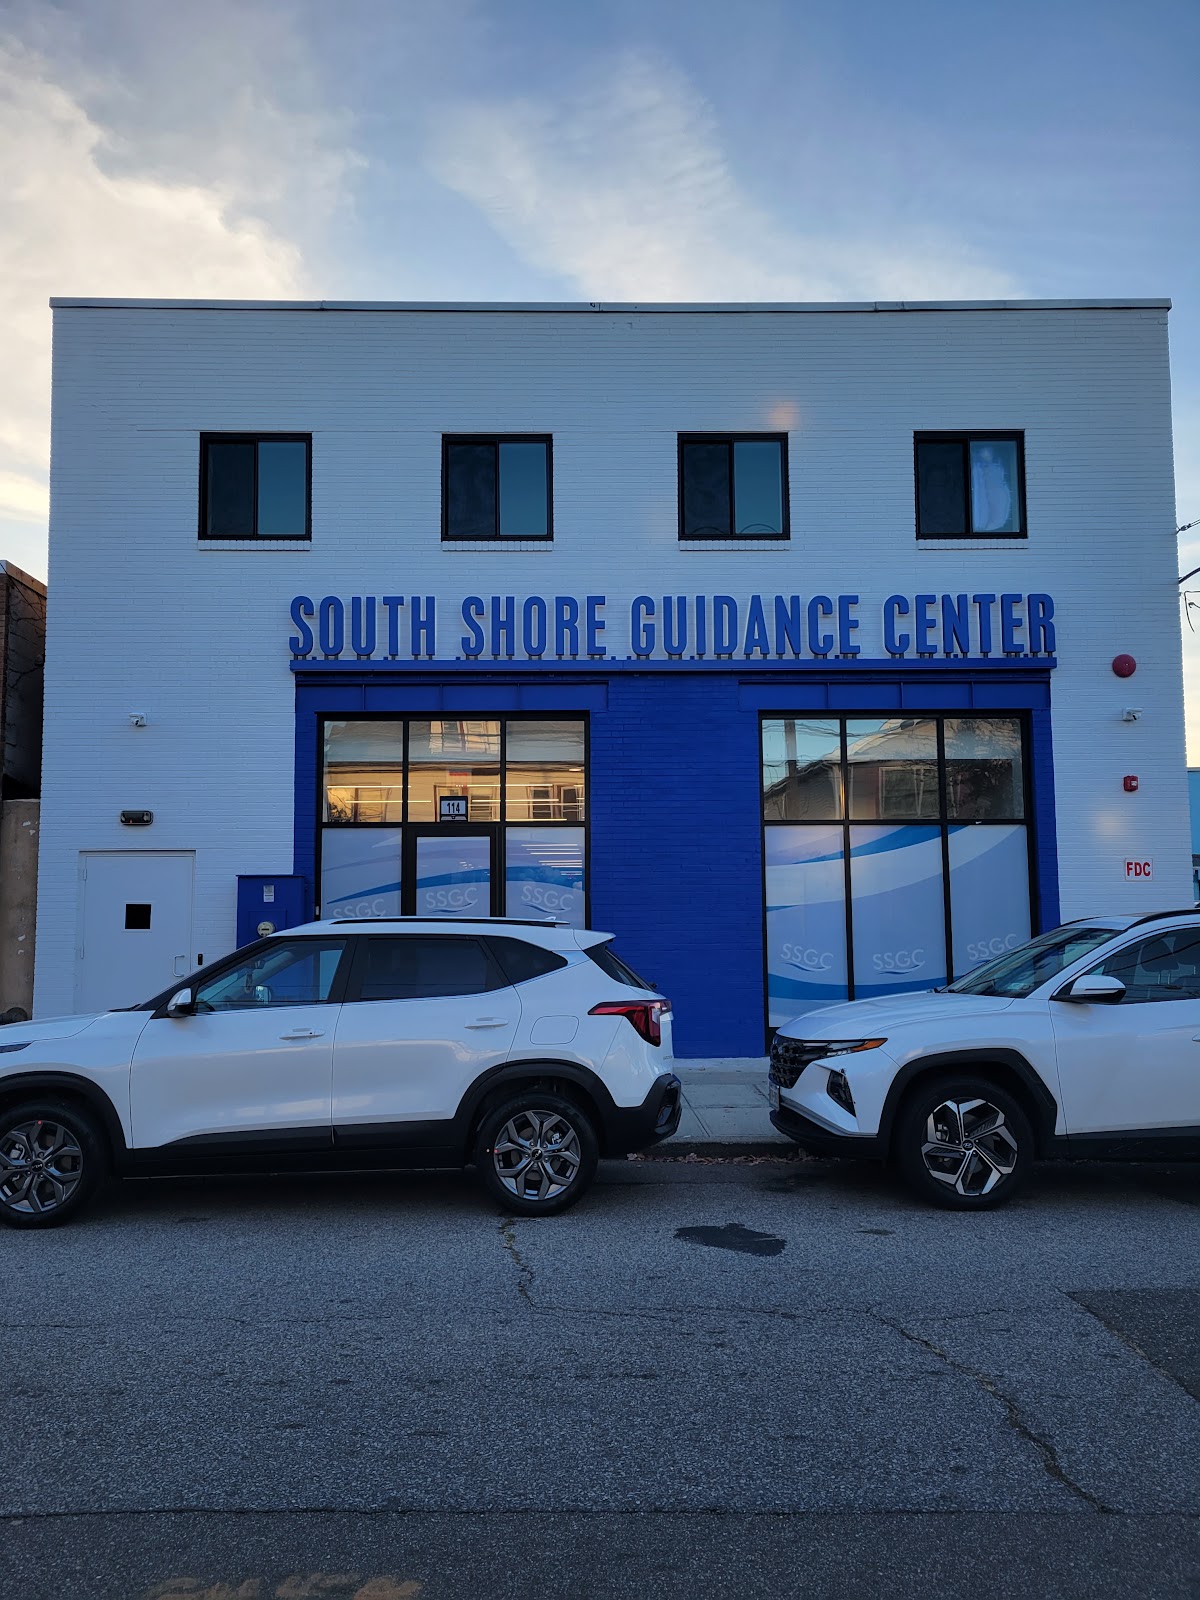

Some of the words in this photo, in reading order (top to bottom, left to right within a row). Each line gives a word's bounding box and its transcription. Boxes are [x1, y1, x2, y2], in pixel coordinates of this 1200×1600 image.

[289, 595, 436, 656] SOUTH
[461, 595, 607, 656] SHORE
[631, 595, 861, 656] GUIDANCE
[883, 593, 1056, 656] CENTER
[446, 802, 460, 814] 114
[1126, 861, 1151, 877] FDC
[333, 899, 386, 918] SSGC
[425, 887, 478, 908] SSGC
[521, 885, 575, 911] SSGC
[780, 943, 834, 969] SSGC
[966, 933, 1017, 961] SSGC
[872, 948, 925, 970] SSGC
